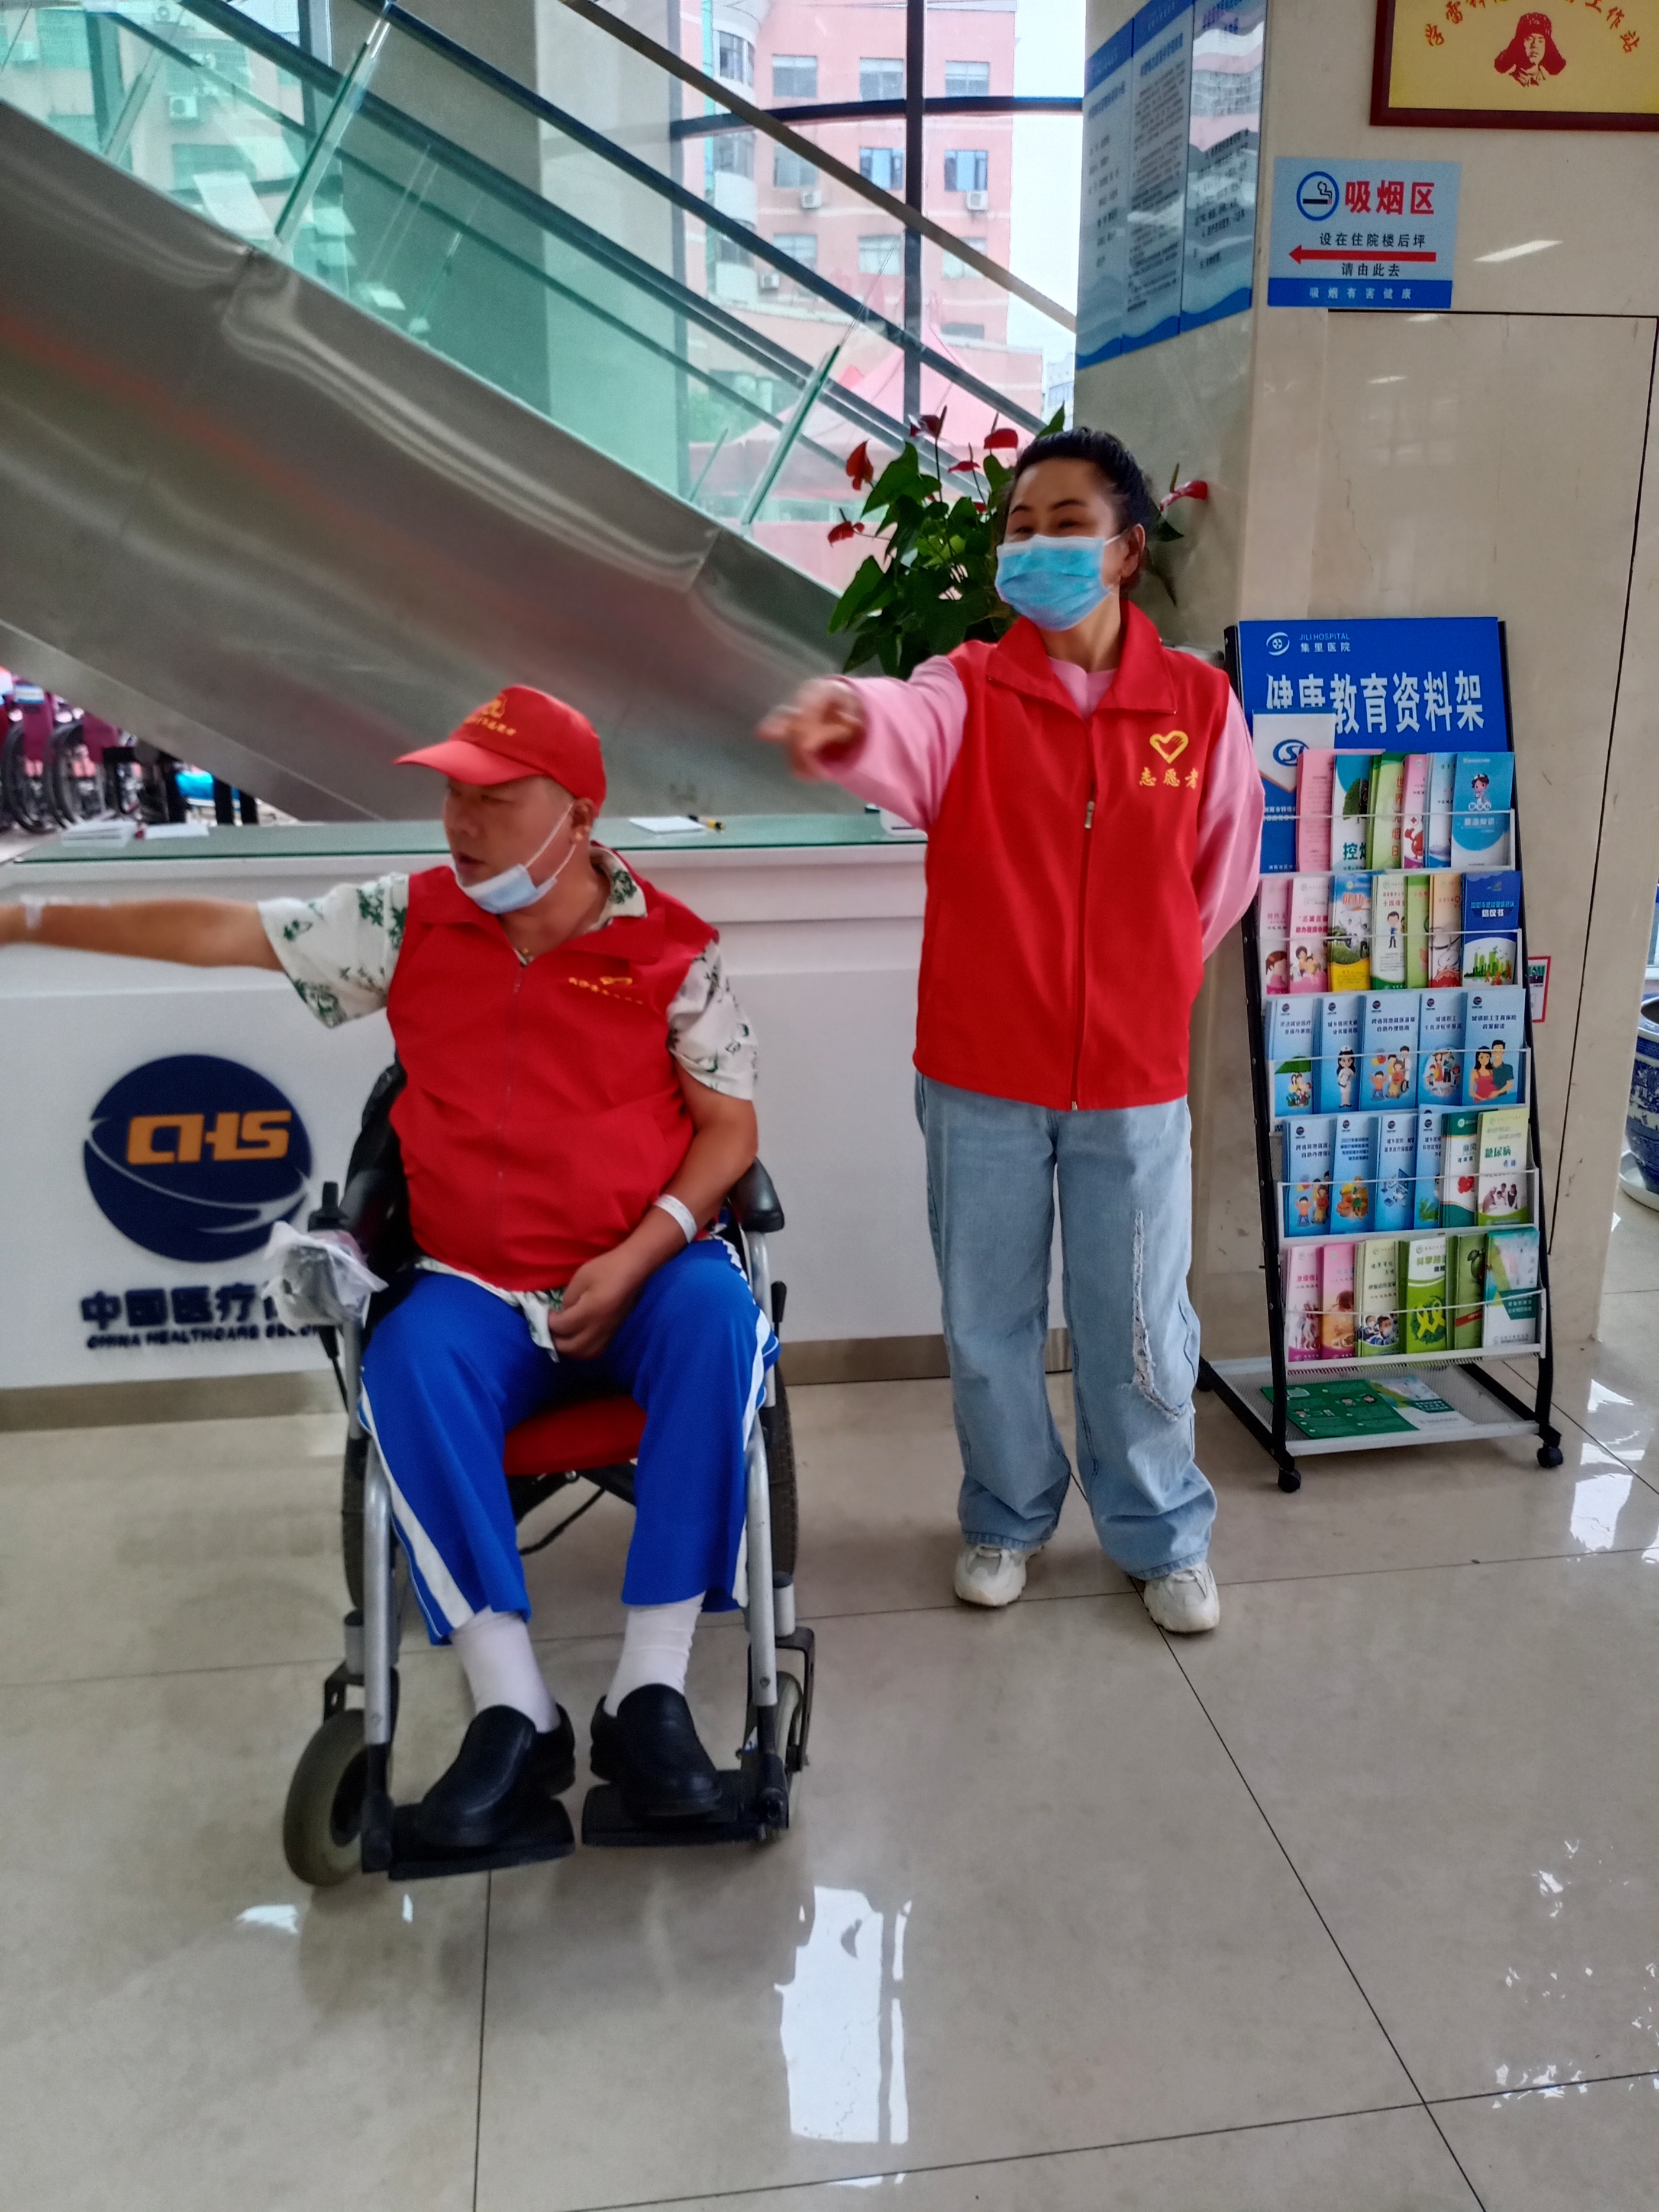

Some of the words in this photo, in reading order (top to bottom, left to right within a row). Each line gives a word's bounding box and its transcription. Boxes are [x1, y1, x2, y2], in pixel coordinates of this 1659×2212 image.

[1345, 180, 1435, 215] 吸烟区
[1319, 233, 1426, 248] 设在住院楼后坪
[1341, 263, 1400, 277] 请由此去
[1309, 286, 1412, 300] 吸烟有害健康
[1313, 633, 1350, 641] HOSPITAL
[1300, 642, 1351, 653] 集里医院
[1139, 766, 1199, 790] 志愿者
[125, 1110, 292, 1165] CHS
